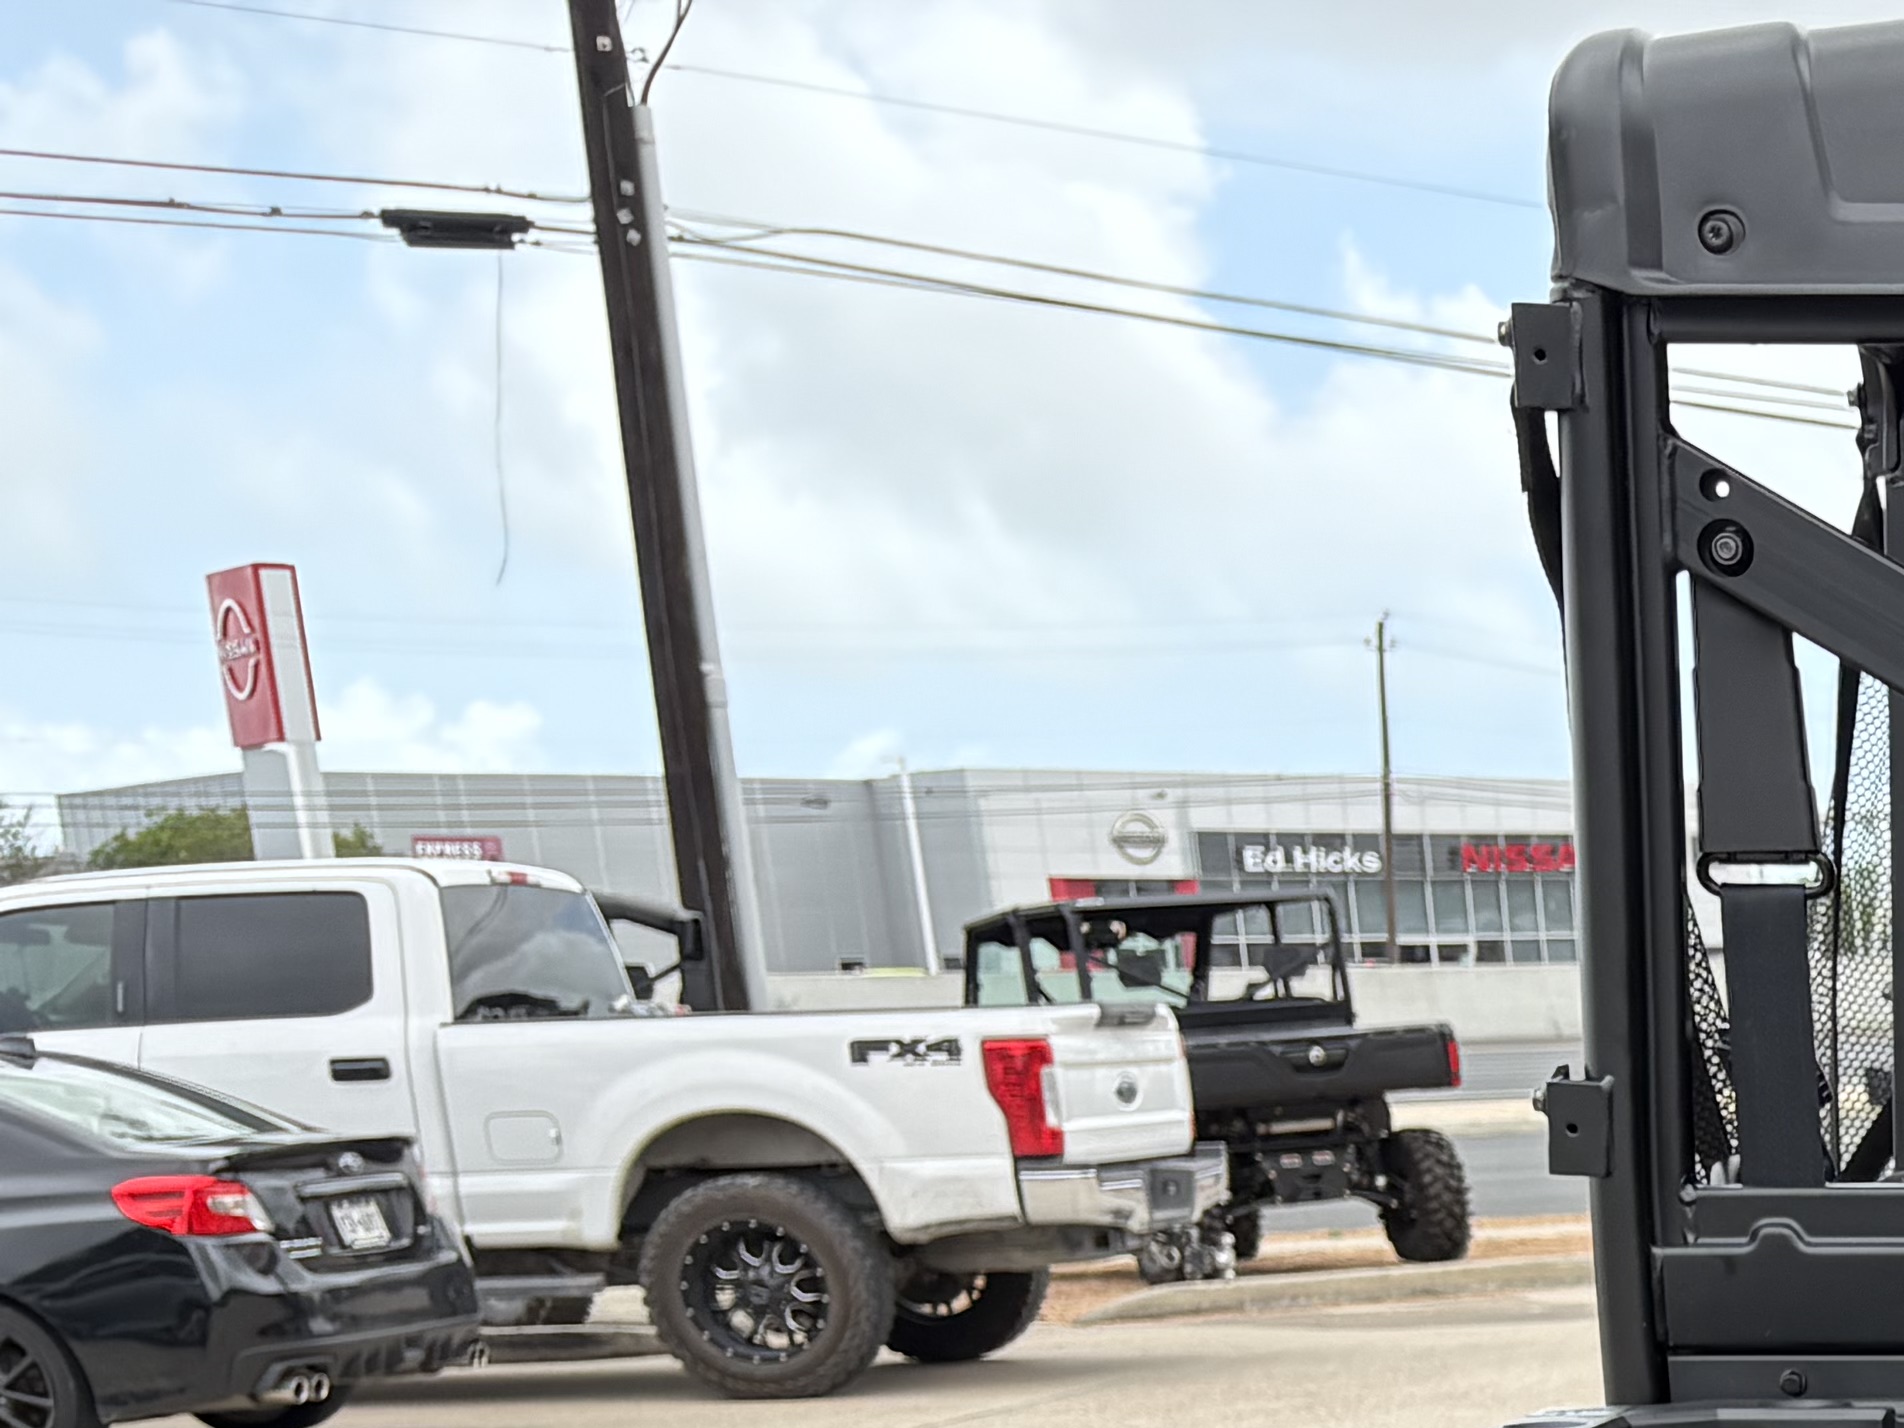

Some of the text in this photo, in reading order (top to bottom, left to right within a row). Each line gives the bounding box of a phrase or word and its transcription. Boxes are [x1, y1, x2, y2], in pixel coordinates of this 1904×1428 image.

[1242, 844, 1382, 873] Ed Hicks
[1462, 843, 1576, 873] NISSA
[849, 1038, 962, 1063] FX4
